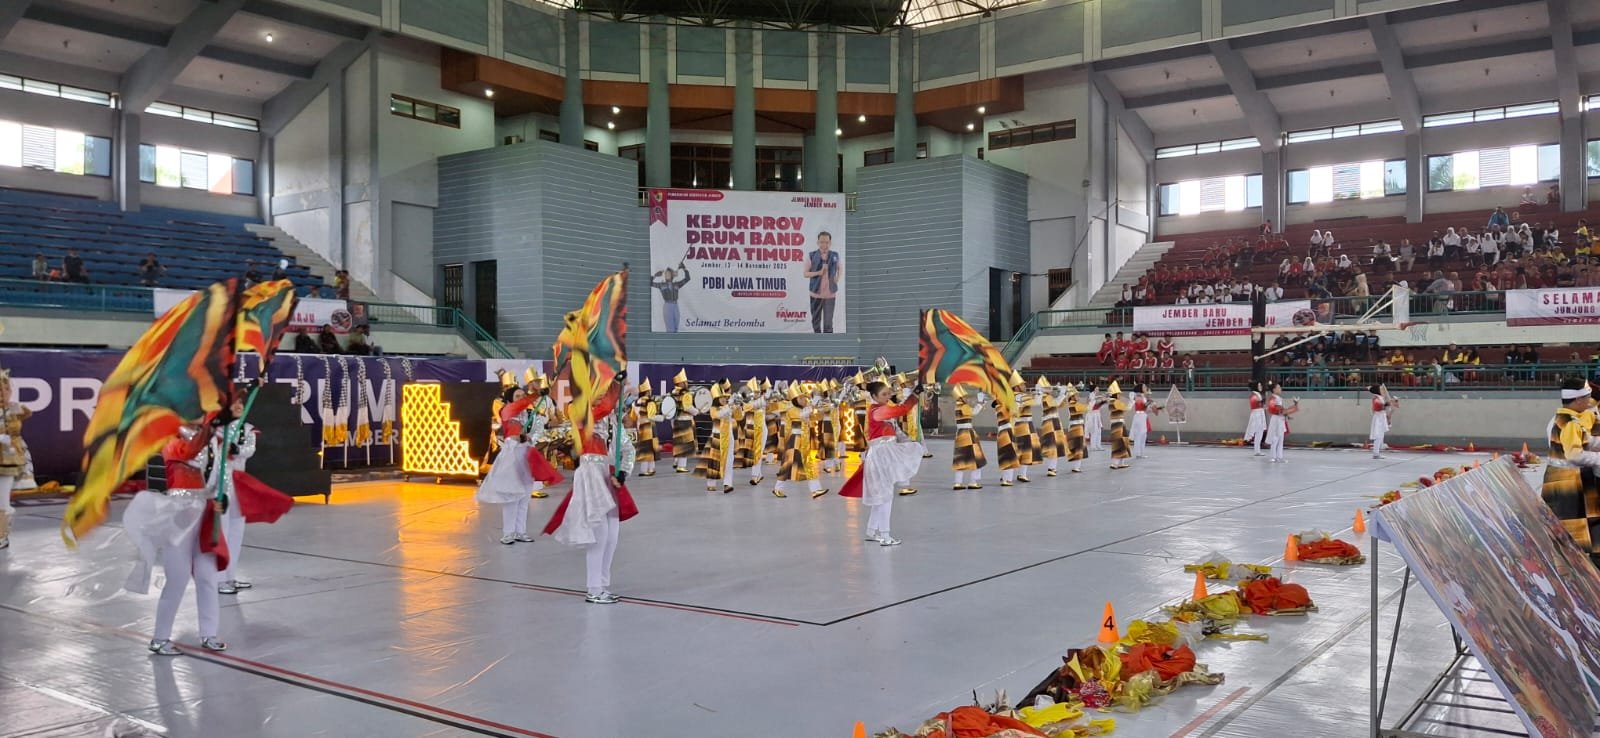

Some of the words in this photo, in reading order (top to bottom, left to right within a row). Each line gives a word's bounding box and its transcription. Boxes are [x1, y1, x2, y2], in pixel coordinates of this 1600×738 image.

[687, 214, 803, 230] KEJURPROV
[687, 231, 744, 245] DRUM
[750, 232, 805, 246] BAND
[687, 247, 741, 260] JAWA
[744, 248, 804, 262] TIMUR
[702, 276, 725, 290] PDBI
[727, 277, 754, 290] JAWA
[756, 278, 787, 290] TIMUR
[1162, 308, 1199, 318] JEMBER
[1202, 308, 1227, 317] BARU
[1554, 305, 1596, 314] JUNJUNG
[685, 318, 721, 328] Selamat
[723, 319, 766, 328] Berlomba
[1205, 318, 1243, 327] JEMBER
[1104, 615, 1114, 631] 4
